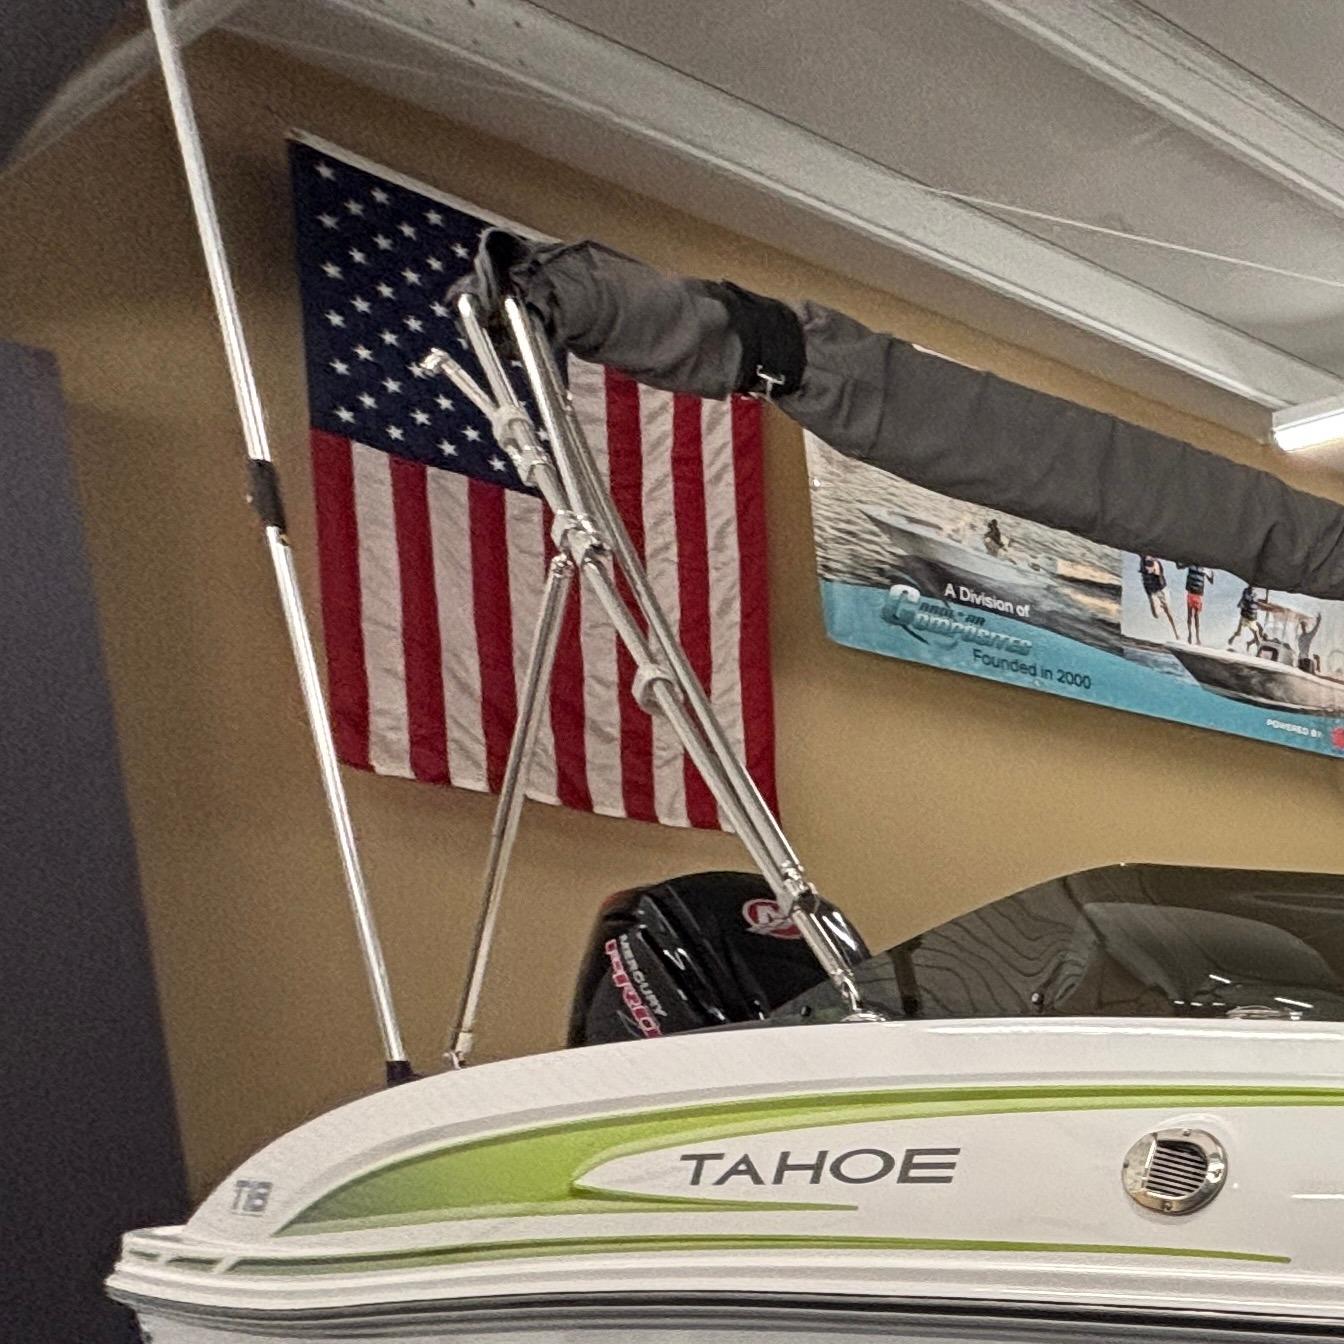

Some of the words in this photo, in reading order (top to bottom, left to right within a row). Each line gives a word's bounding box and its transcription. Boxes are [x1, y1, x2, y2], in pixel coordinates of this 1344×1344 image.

[943, 583, 957, 599] A
[958, 586, 1015, 614] Division
[1015, 602, 1031, 618] of
[972, 648, 1037, 677] Founded
[1040, 667, 1053, 680] in
[1056, 668, 1092, 690] 2000
[619, 933, 668, 1017] MERCURY
[679, 1147, 961, 1186] TAHOE
